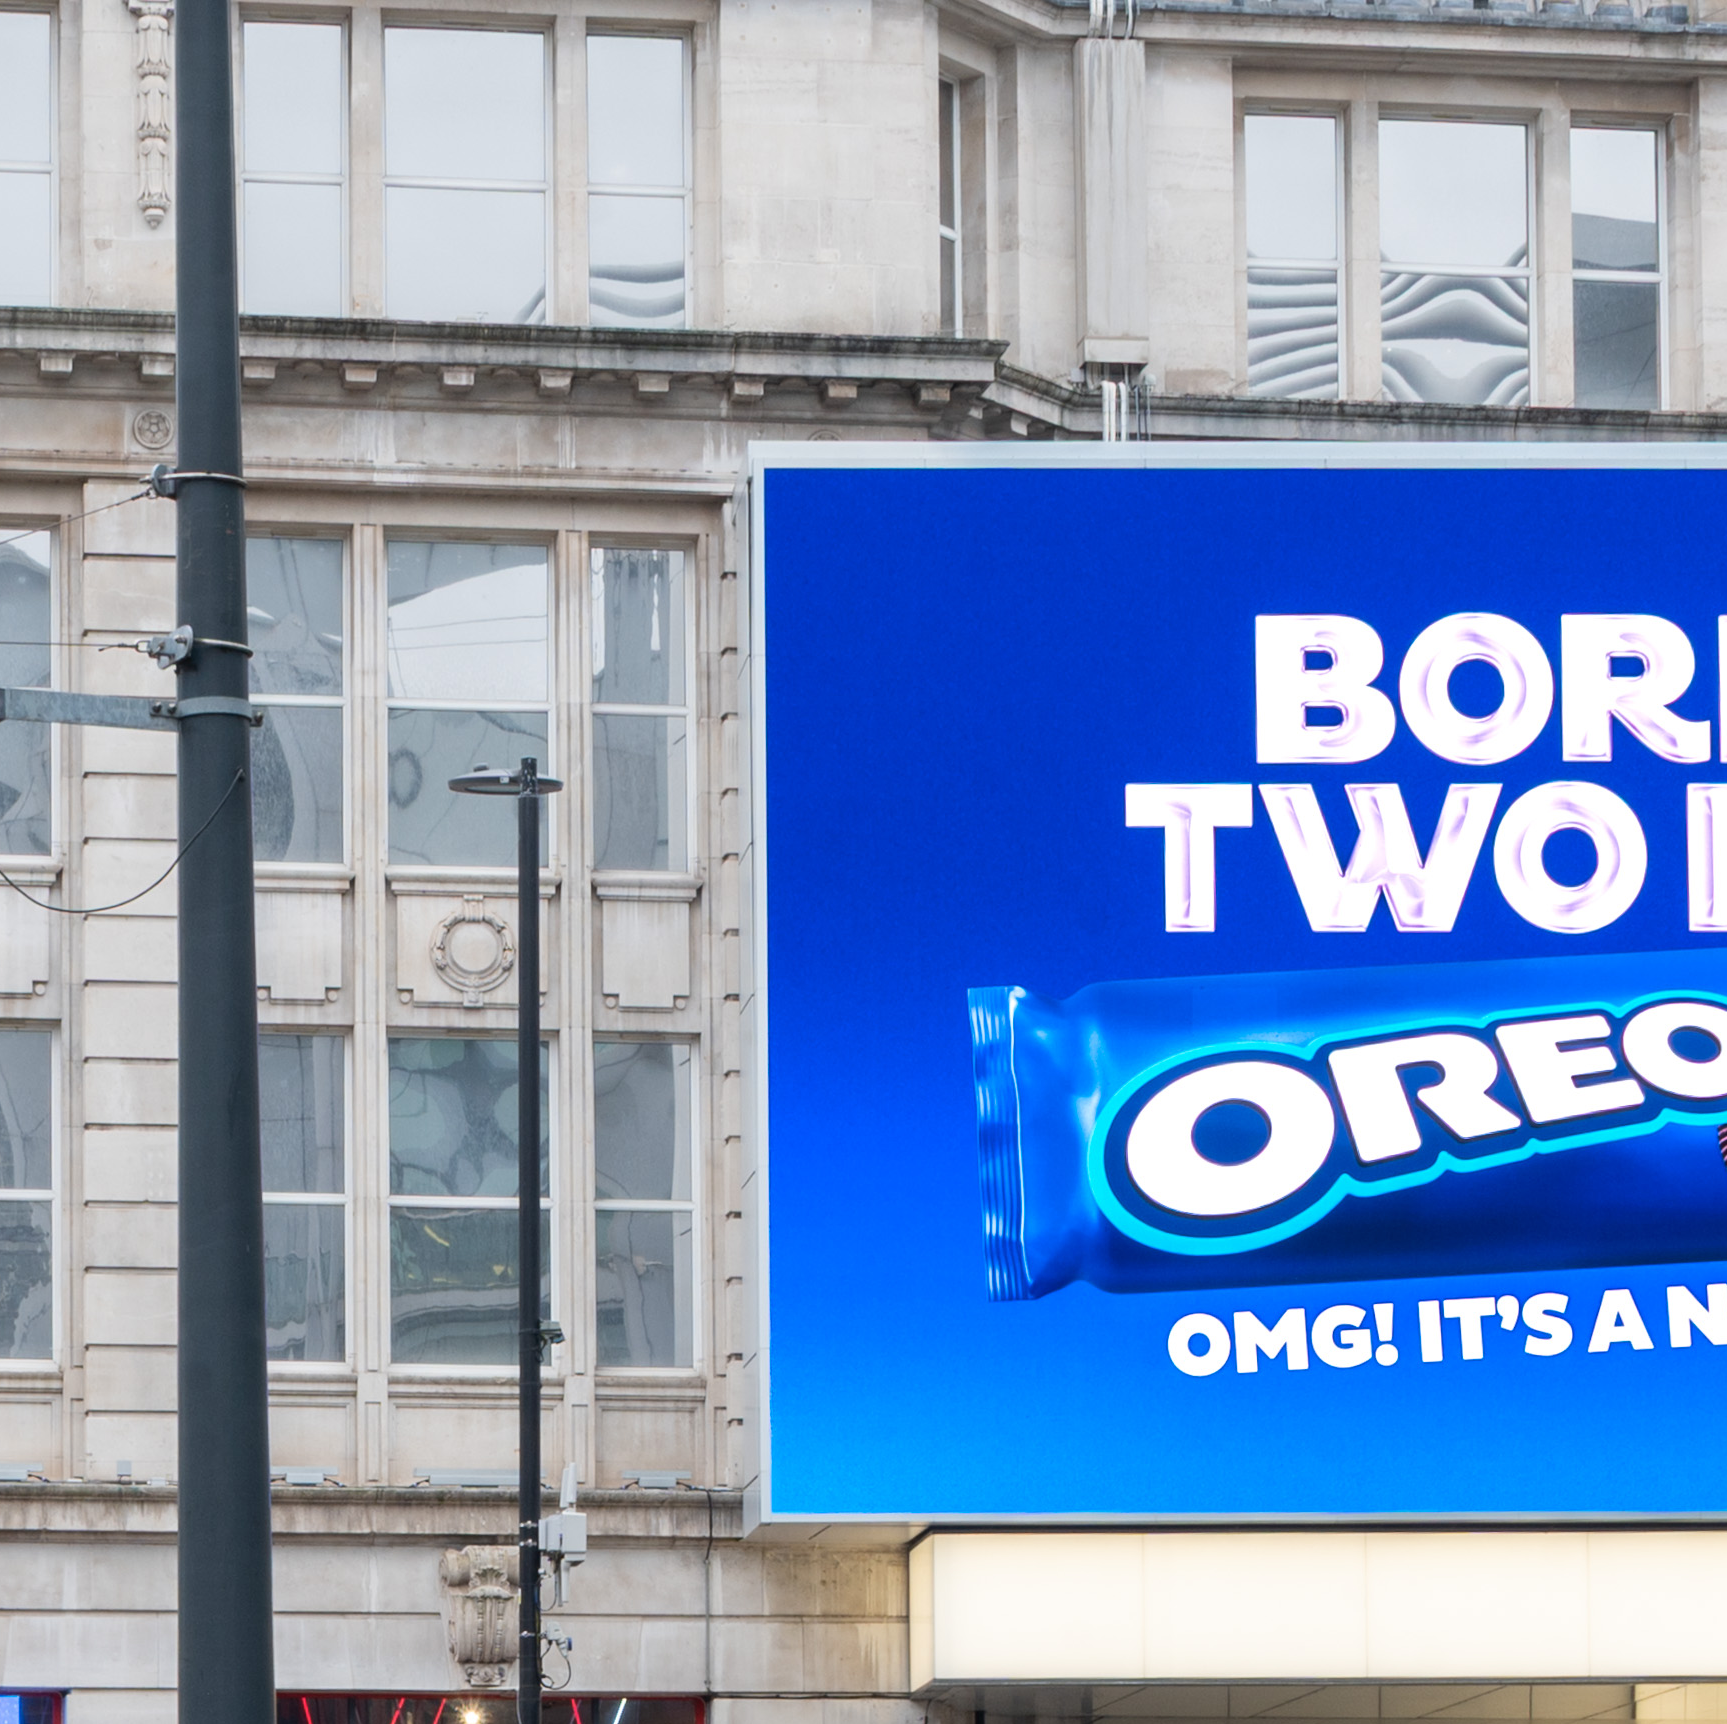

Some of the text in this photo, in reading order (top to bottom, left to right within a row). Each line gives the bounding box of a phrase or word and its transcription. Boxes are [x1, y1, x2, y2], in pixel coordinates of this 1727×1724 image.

[1125, 780, 1648, 934] TWO
[1166, 1302, 1399, 1377] OMG!
[1419, 1290, 1574, 1364] IT'S
[1587, 1289, 1655, 1353] A
